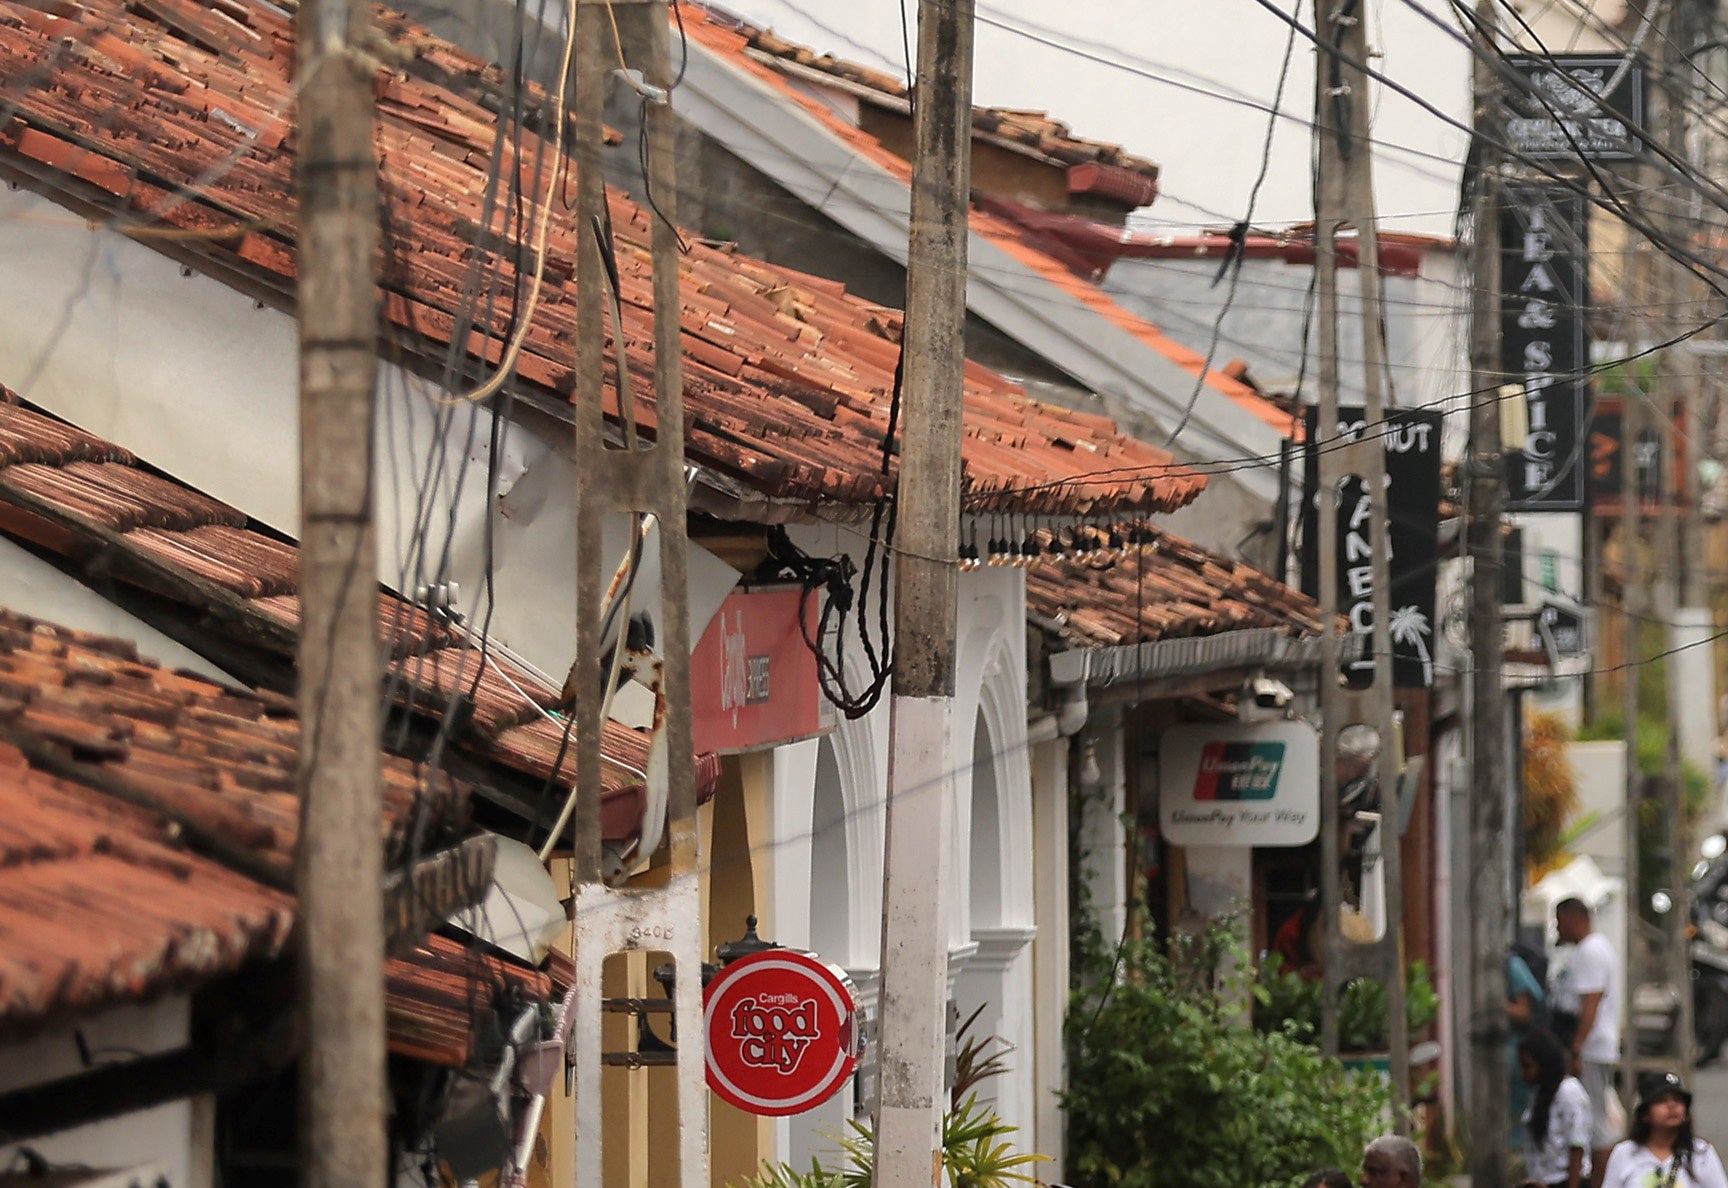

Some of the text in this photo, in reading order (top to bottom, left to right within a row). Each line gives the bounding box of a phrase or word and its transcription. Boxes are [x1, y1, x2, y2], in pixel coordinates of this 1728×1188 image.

[731, 998, 820, 1039] food
[759, 992, 799, 1005] Cargills
[741, 1032, 809, 1075] city
